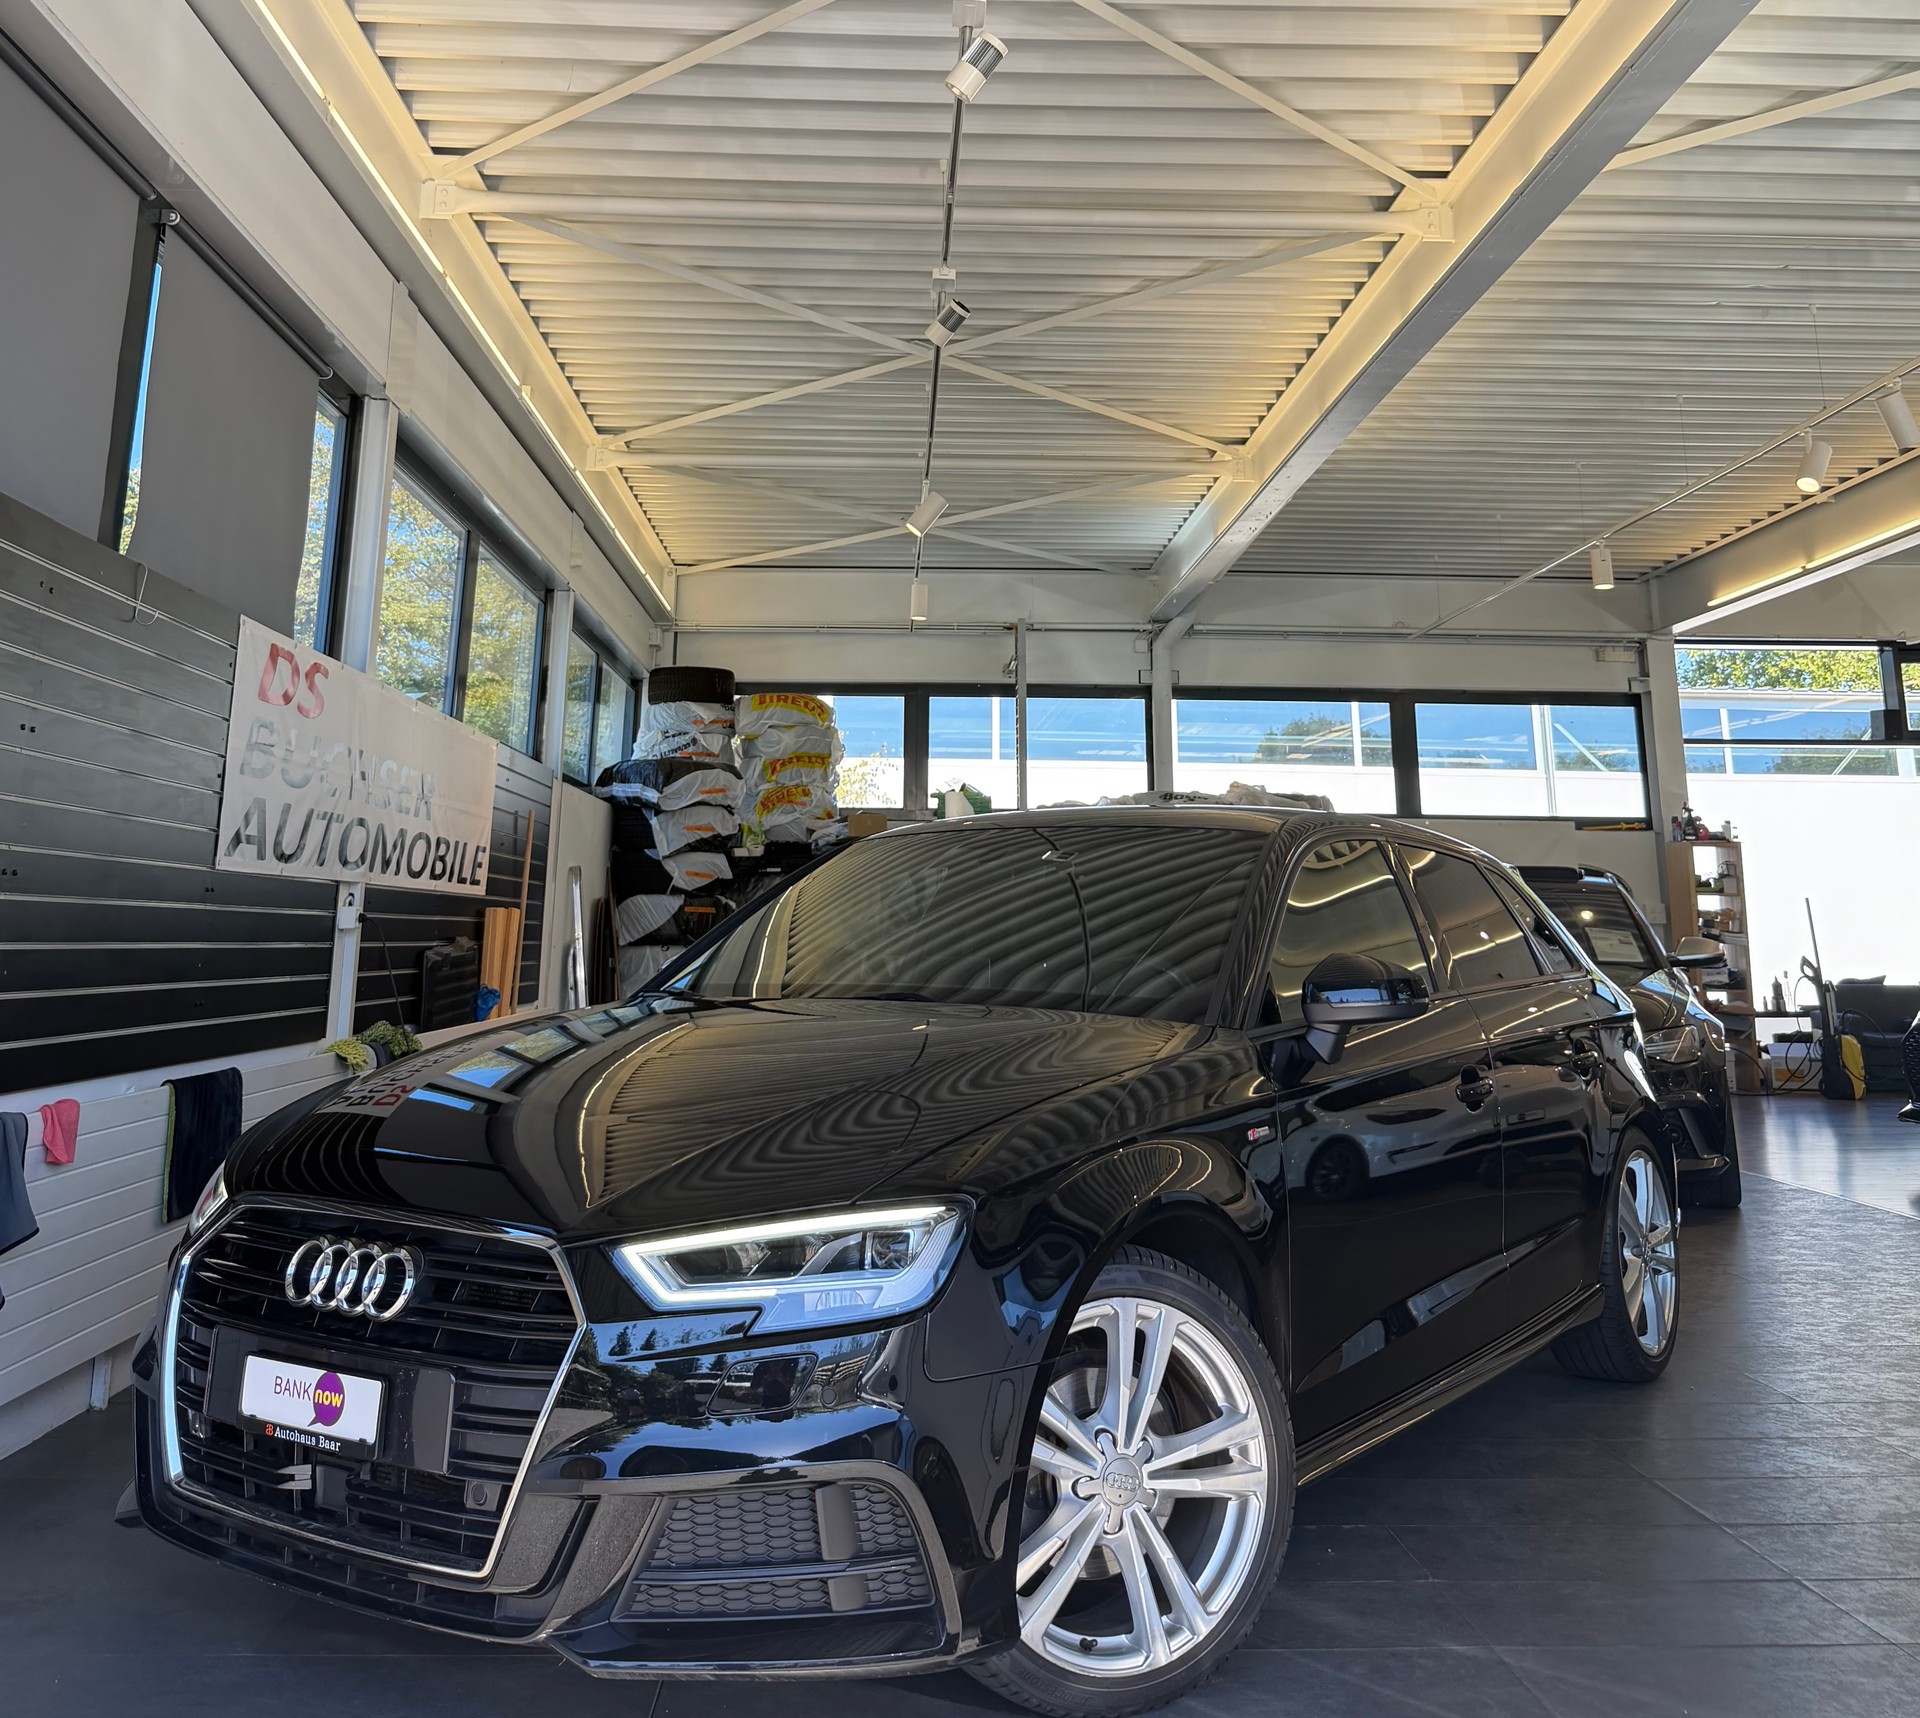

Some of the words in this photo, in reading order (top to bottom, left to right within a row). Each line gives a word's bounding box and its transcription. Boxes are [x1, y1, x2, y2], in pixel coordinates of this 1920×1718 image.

[257, 642, 330, 720] DS
[223, 796, 487, 887] AUTOMOBILE
[274, 1376, 312, 1401] BANK
[314, 1388, 344, 1408] now
[274, 1425, 316, 1446] Autohaus
[319, 1436, 341, 1452] Baar
